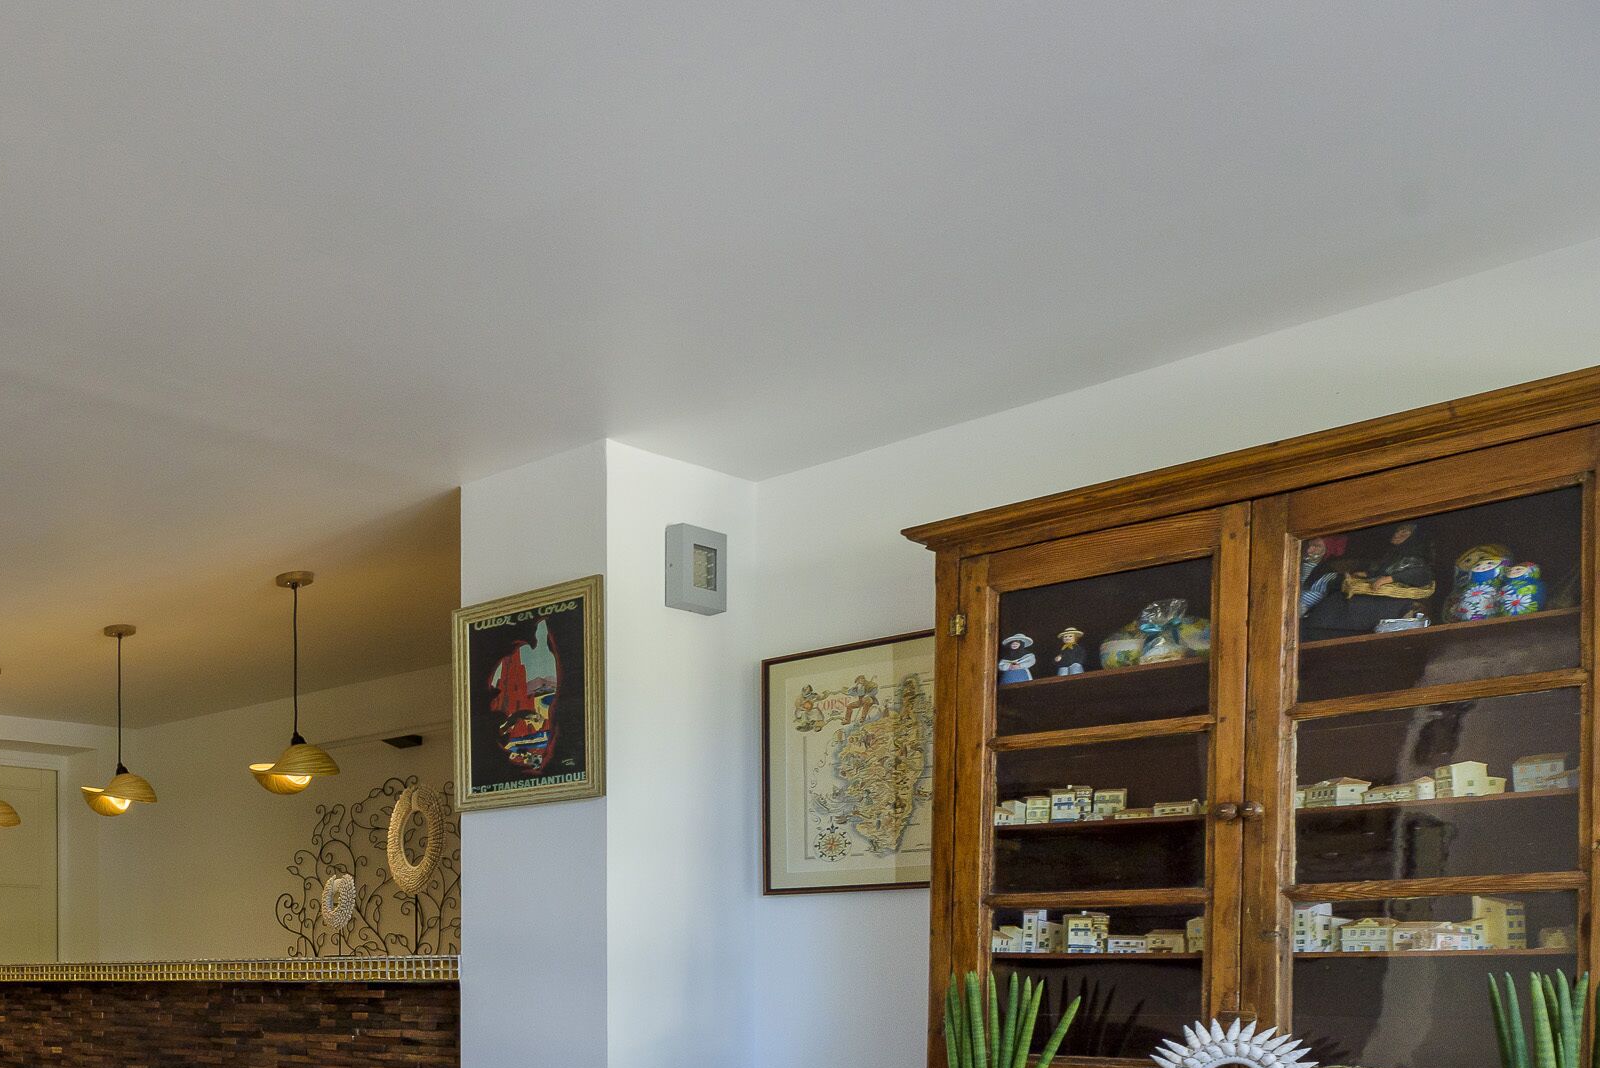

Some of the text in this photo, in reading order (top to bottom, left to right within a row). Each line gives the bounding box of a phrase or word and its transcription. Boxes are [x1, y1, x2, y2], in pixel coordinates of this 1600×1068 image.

[518, 612, 534, 622] en
[538, 601, 578, 616] Corse
[493, 771, 587, 792] TRANSATLANTIQUE
